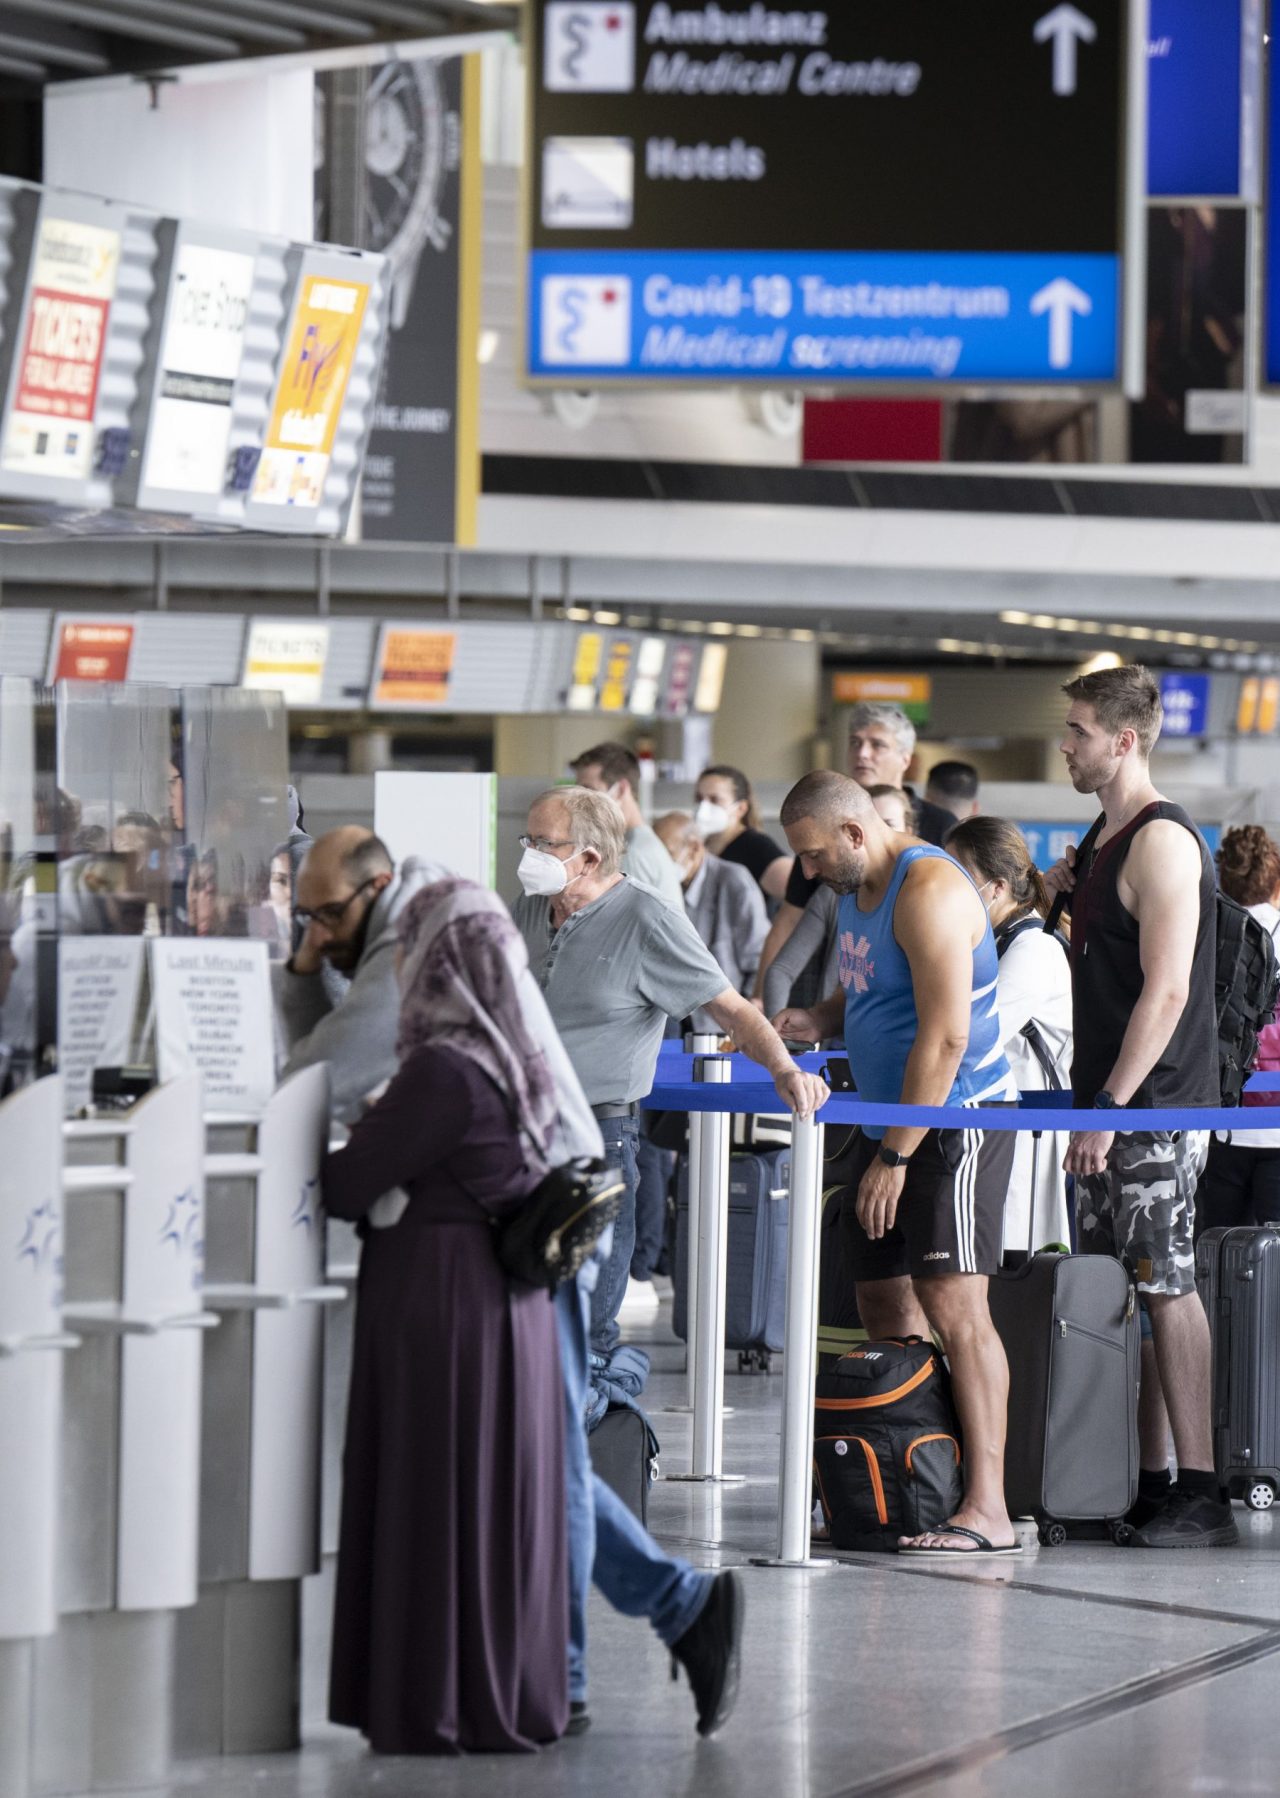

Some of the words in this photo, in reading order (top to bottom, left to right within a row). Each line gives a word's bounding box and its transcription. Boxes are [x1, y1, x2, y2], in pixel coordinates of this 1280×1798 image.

[646, 3, 827, 45] Ambulanz
[645, 52, 795, 94] Medical
[798, 52, 921, 96] Centre
[646, 137, 765, 179] Hotels
[644, 275, 792, 317] Covid-19
[799, 276, 1009, 318] Testzentrum
[641, 325, 787, 368] Medical
[791, 328, 962, 376] screening
[167, 953, 197, 970] Last
[203, 954, 255, 972] Minute
[922, 1251, 950, 1260] adidas
